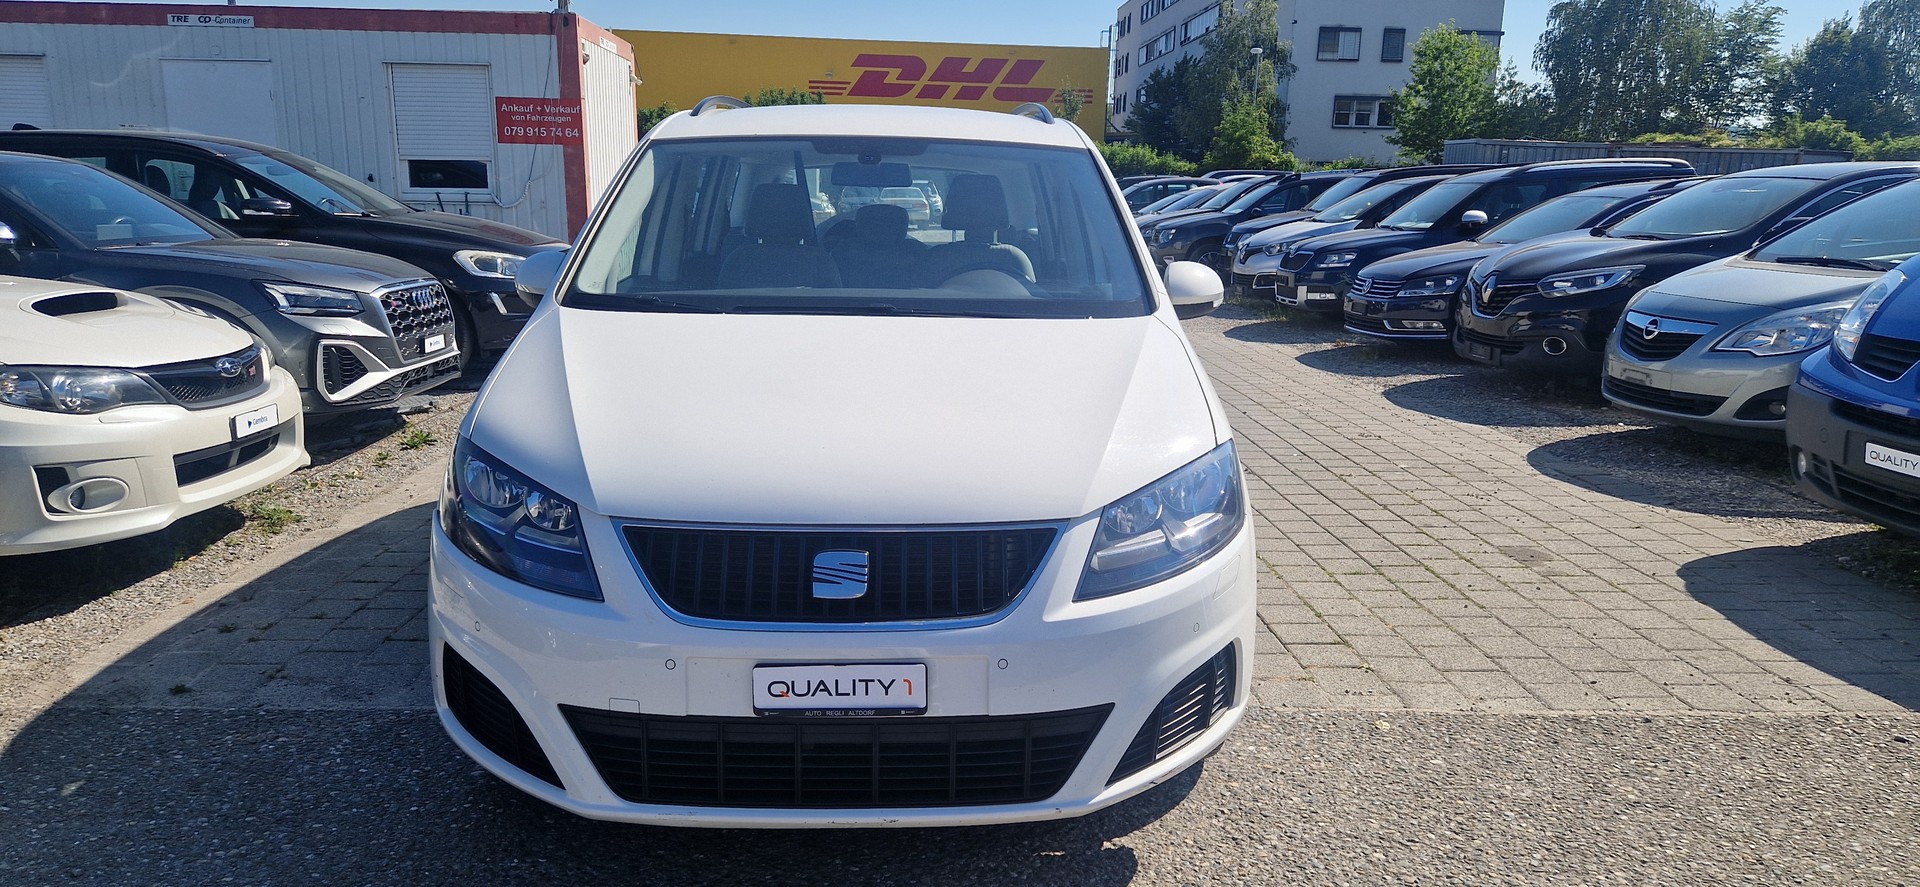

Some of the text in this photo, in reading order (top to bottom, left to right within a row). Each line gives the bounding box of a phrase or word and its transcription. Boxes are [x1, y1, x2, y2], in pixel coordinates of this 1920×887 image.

[171, 15, 189, 23] TRE
[847, 53, 1056, 103] DHL
[501, 103, 533, 113] Ankauf
[544, 104, 580, 114] Verkauf
[527, 114, 571, 123] Fahrzeugen
[504, 126, 579, 138] 079 915 74 64
[1870, 450, 1919, 470] QUALITY
[767, 678, 913, 698] QUALITY 1
